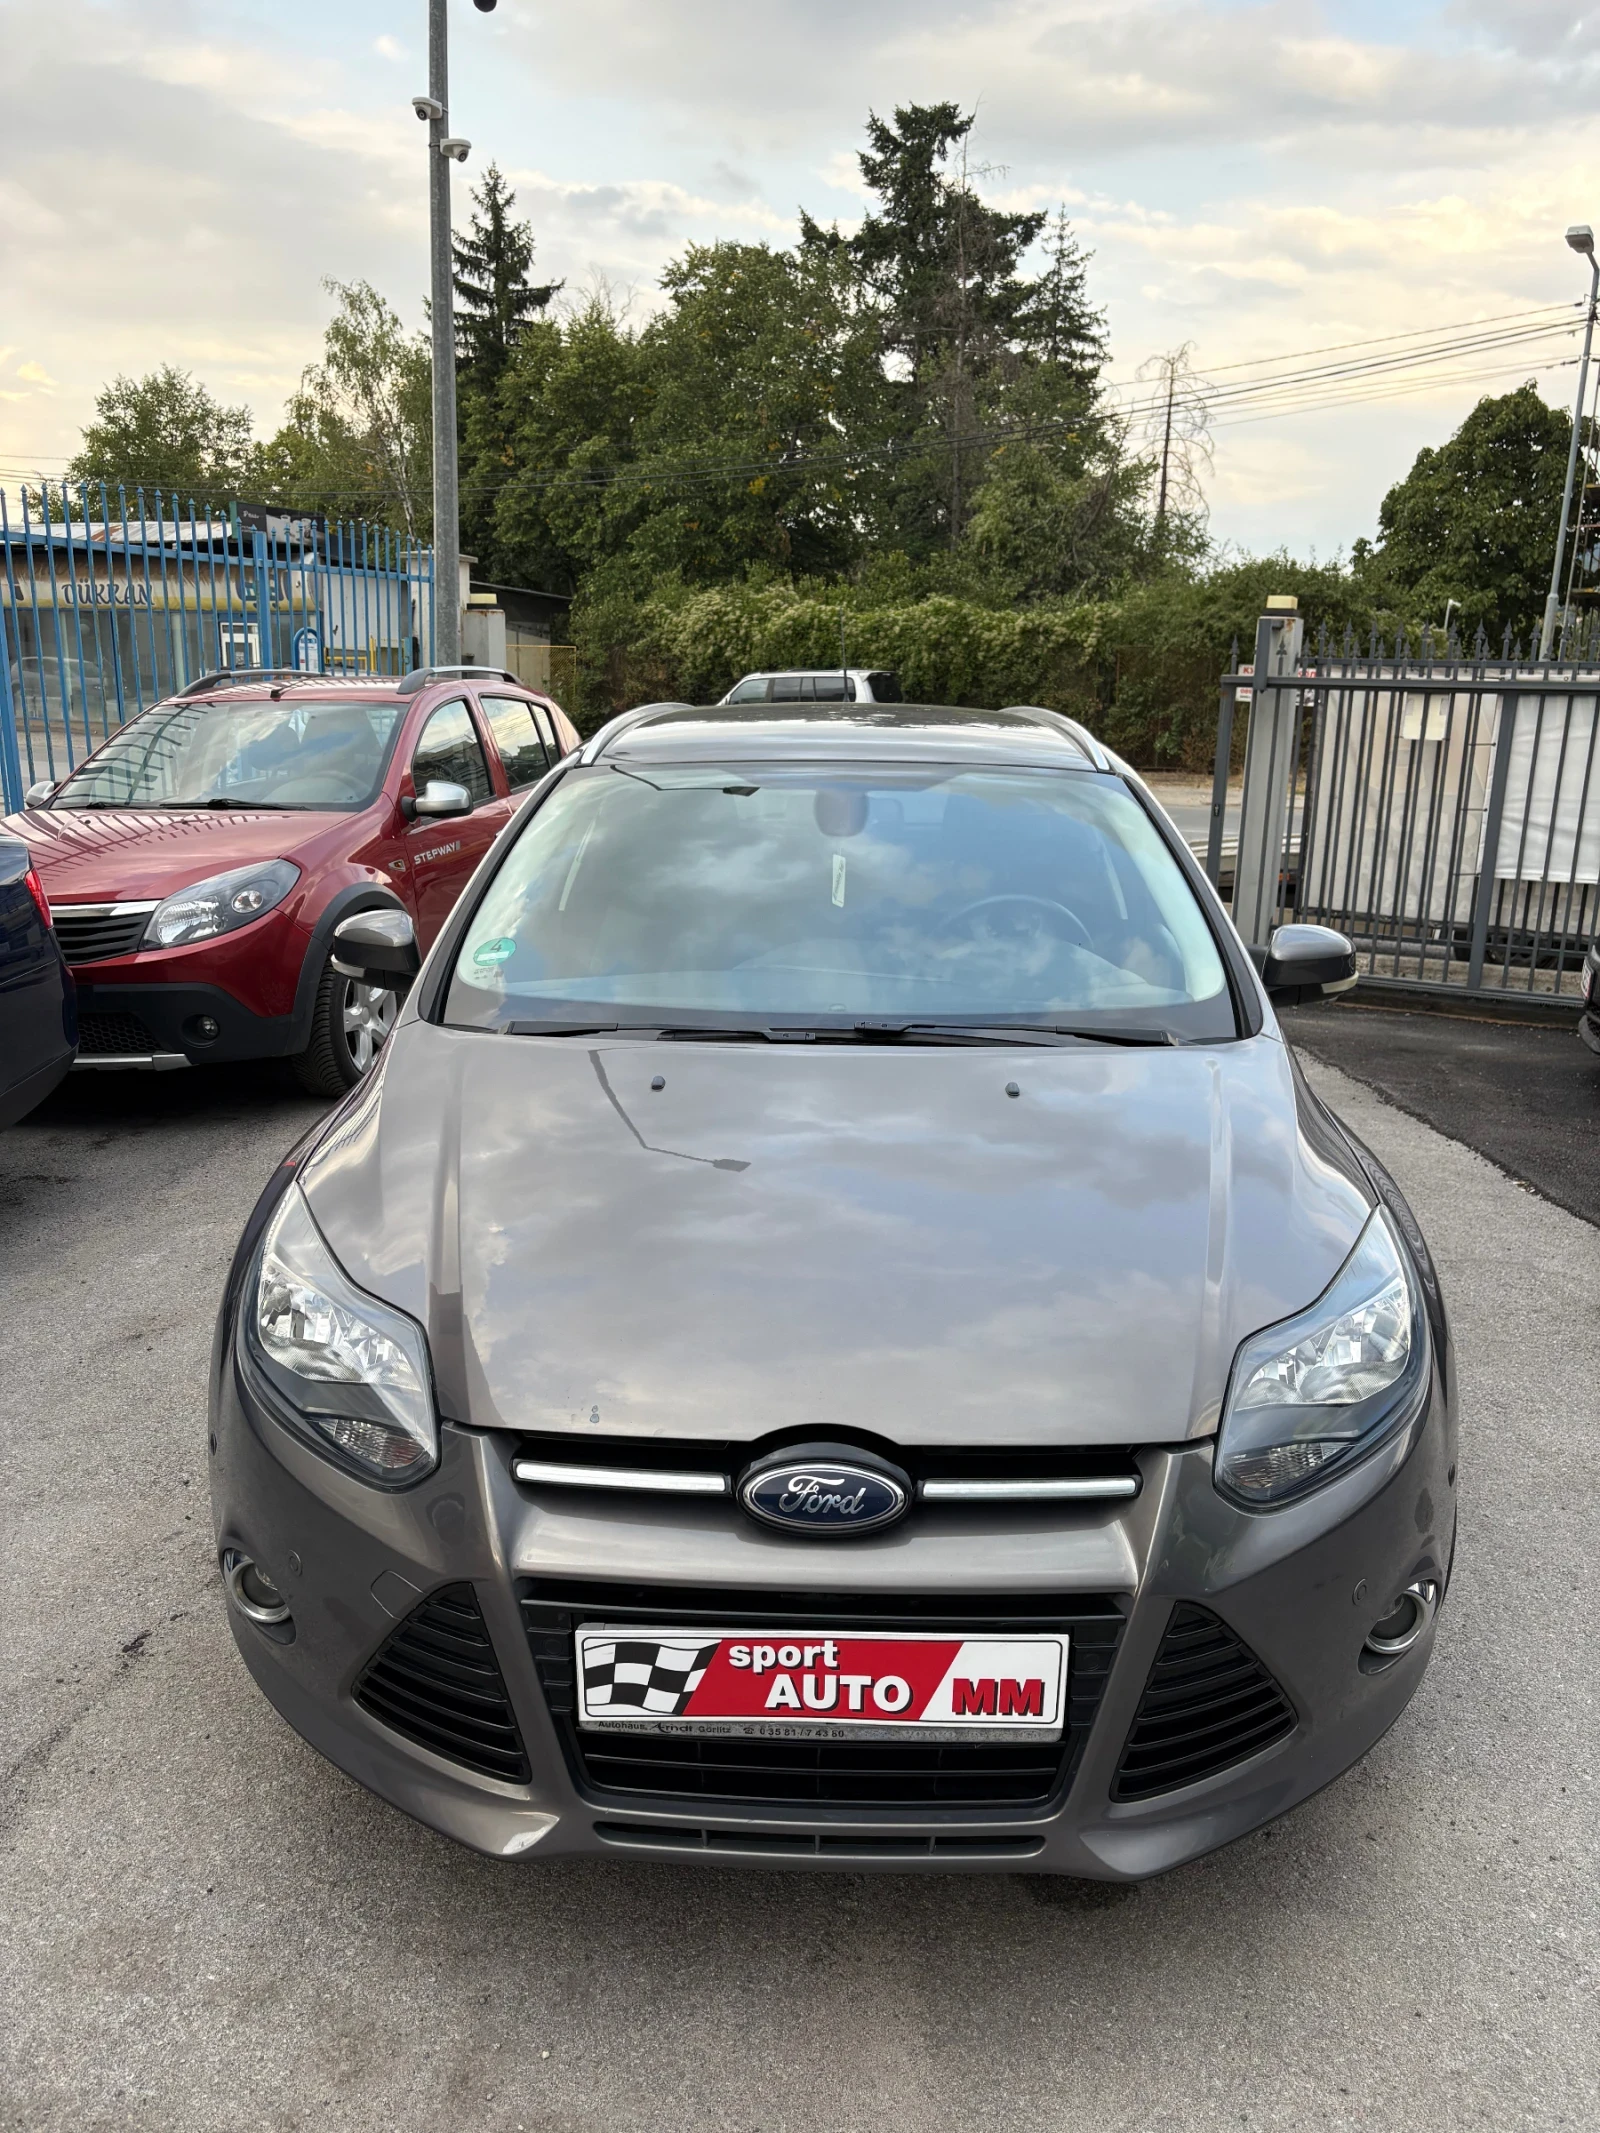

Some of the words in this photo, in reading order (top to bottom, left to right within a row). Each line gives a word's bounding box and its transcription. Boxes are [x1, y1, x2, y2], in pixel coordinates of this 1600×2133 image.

[414, 842, 455, 865] STEPWAY
[490, 940, 502, 952] 4
[778, 1475, 867, 1515] Ford
[728, 1640, 840, 1674] sport
[764, 1674, 914, 1712] AUTO
[952, 1678, 1045, 1716] MM
